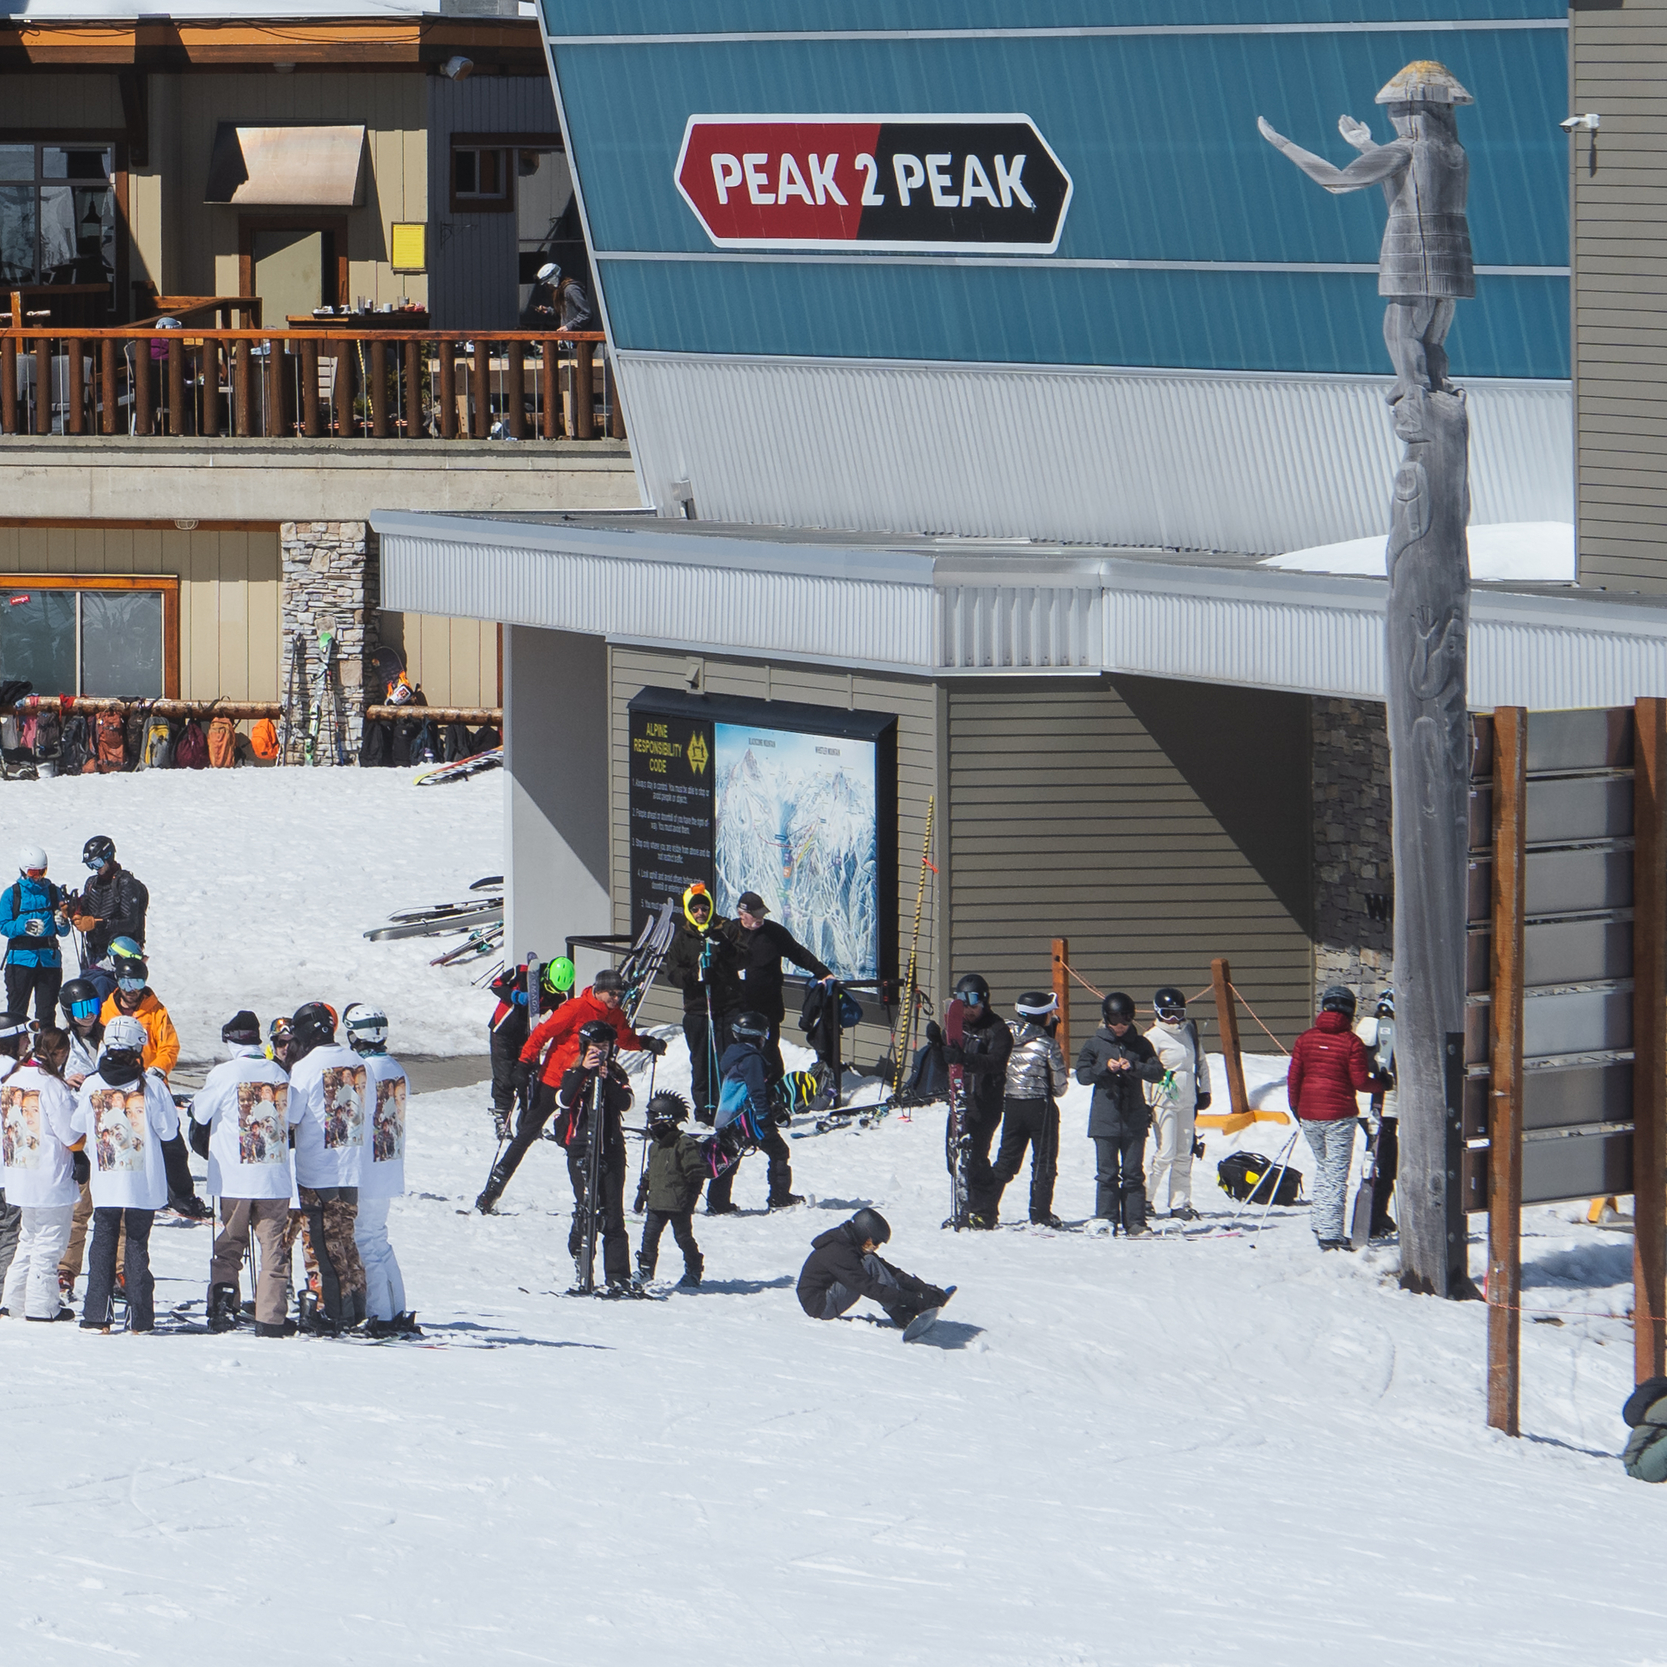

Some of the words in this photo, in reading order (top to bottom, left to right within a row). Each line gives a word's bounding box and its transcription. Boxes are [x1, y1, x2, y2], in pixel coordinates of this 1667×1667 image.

[710, 153, 849, 206] PEAK
[854, 153, 886, 206] 2
[893, 153, 1036, 209] PEAK
[645, 722, 668, 738] ALPINE
[633, 738, 683, 758] RESPONSIBILITY
[649, 758, 667, 773] CODE
